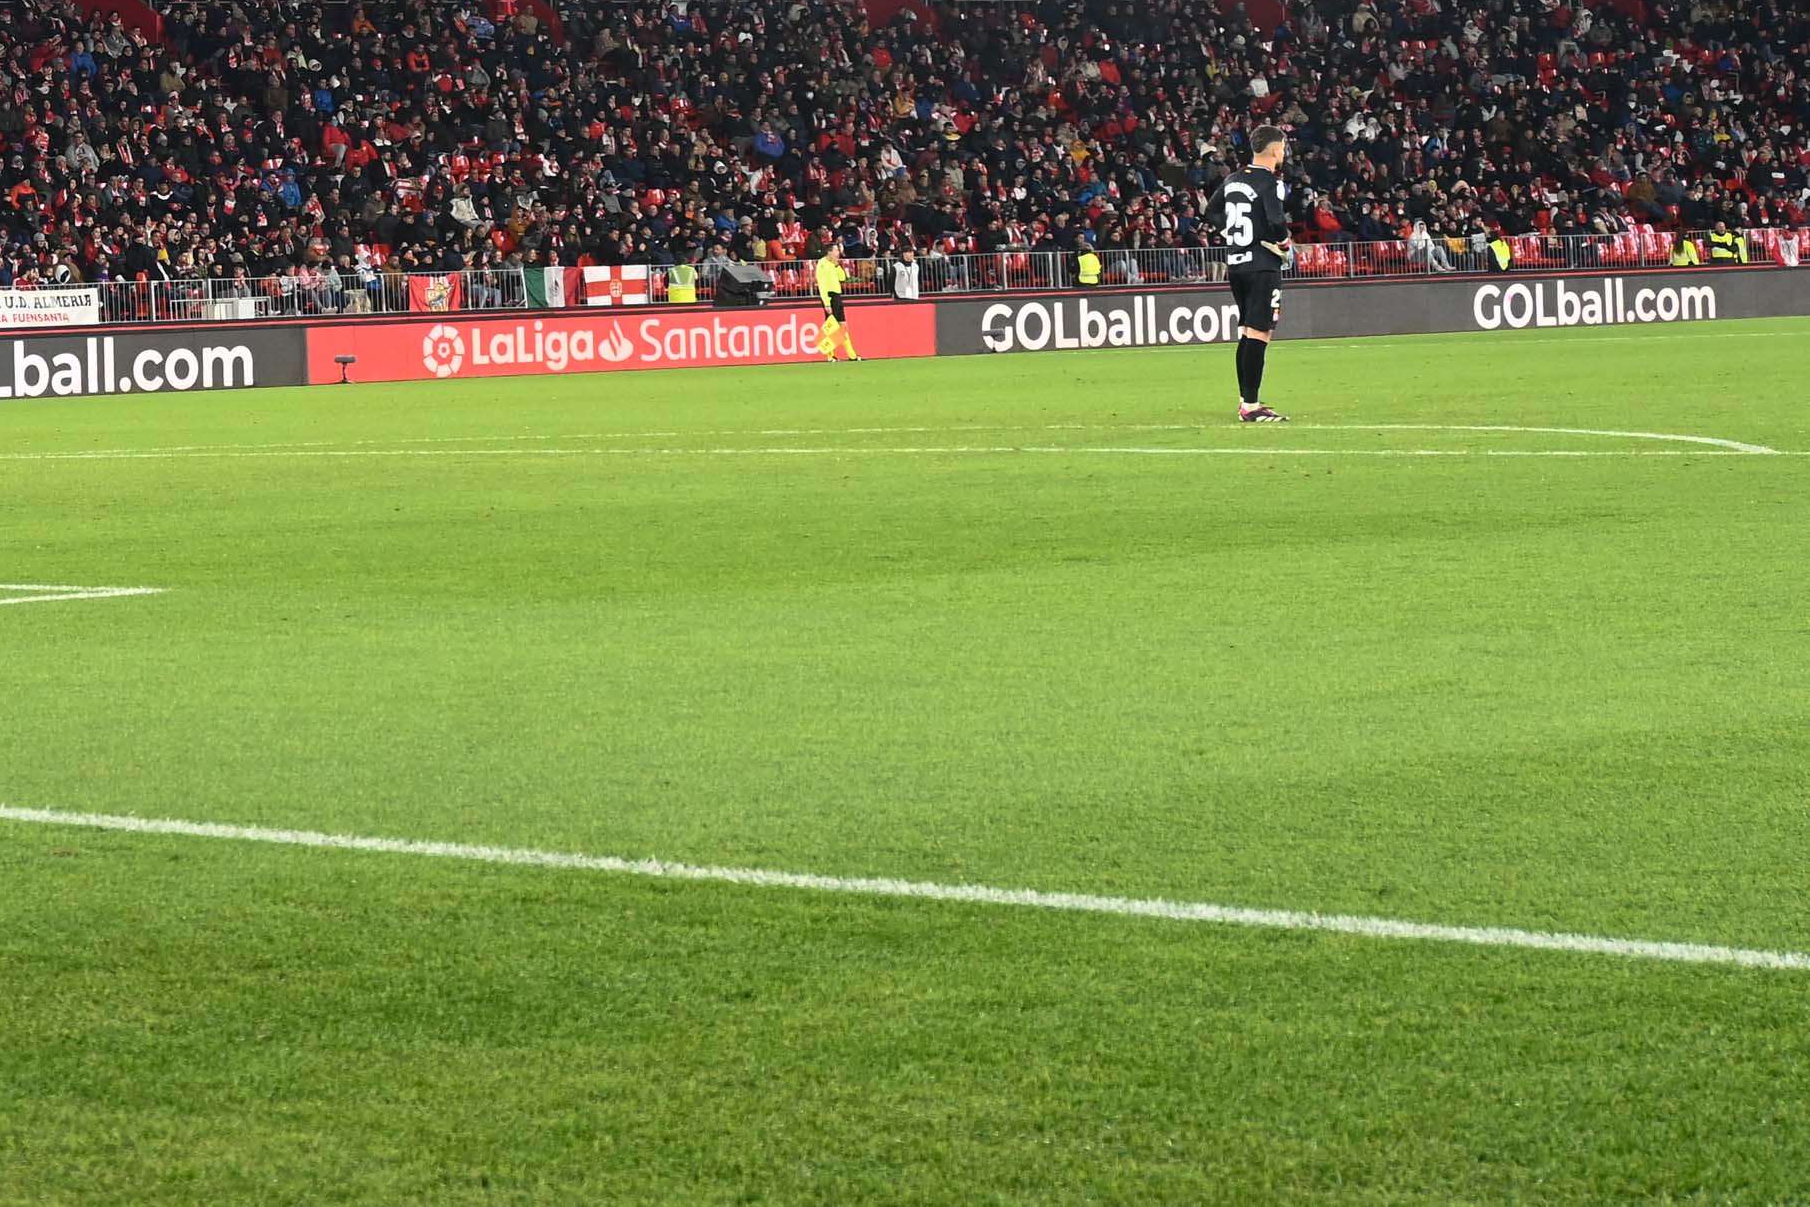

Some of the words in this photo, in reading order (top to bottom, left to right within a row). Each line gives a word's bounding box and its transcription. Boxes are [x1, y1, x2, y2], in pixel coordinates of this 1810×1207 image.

[1224, 201, 1254, 247] 25
[5, 294, 31, 309] U.D.
[34, 294, 91, 309] ALMERIA
[1270, 288, 1283, 308] 2
[1473, 277, 1716, 329] GOLball.com
[13, 312, 70, 324] FUENSANTA
[471, 320, 595, 371] LaLiga
[639, 313, 822, 362] Santande
